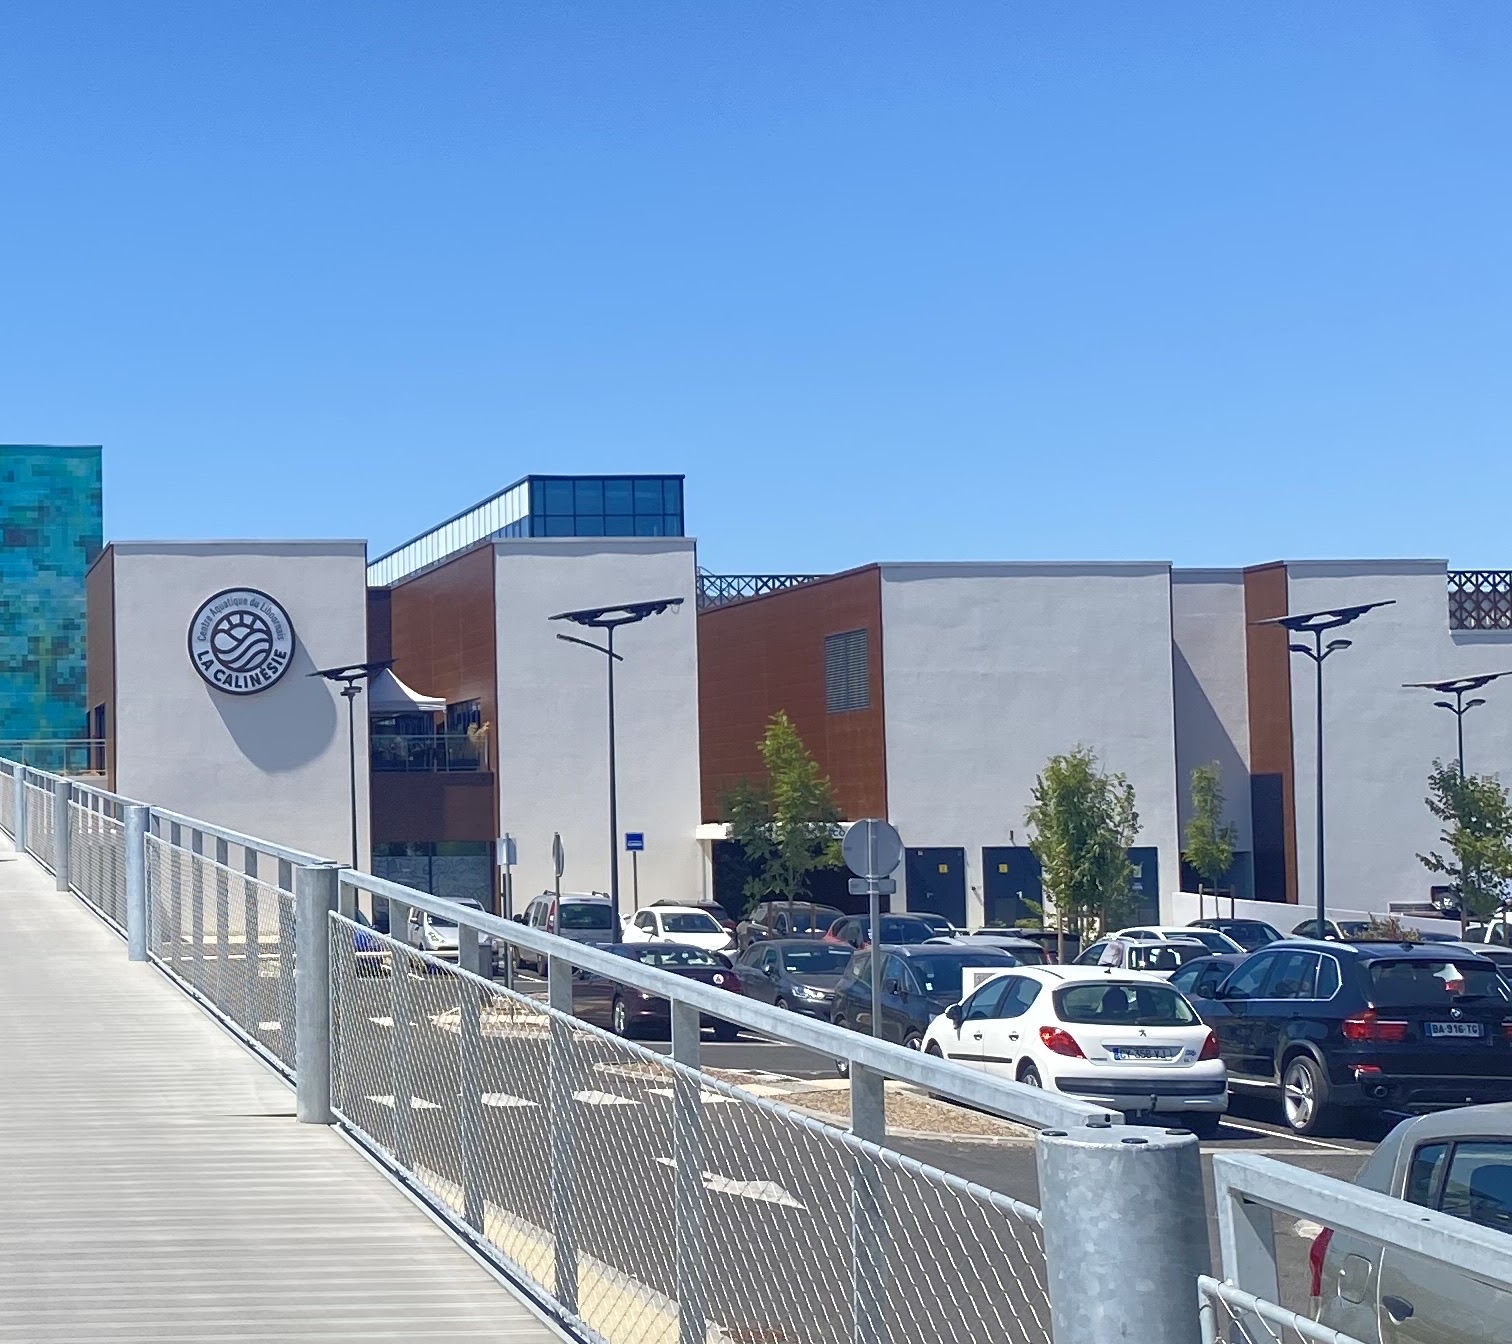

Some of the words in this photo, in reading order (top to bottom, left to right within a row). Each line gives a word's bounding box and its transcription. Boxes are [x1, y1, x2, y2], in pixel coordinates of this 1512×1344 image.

[197, 614, 213, 641] Centre
[209, 597, 248, 616] Aquatique
[249, 598, 260, 608] du
[259, 602, 284, 641] Libournais
[197, 650, 214, 672] LA
[213, 649, 287, 689] CALINÉSIE
